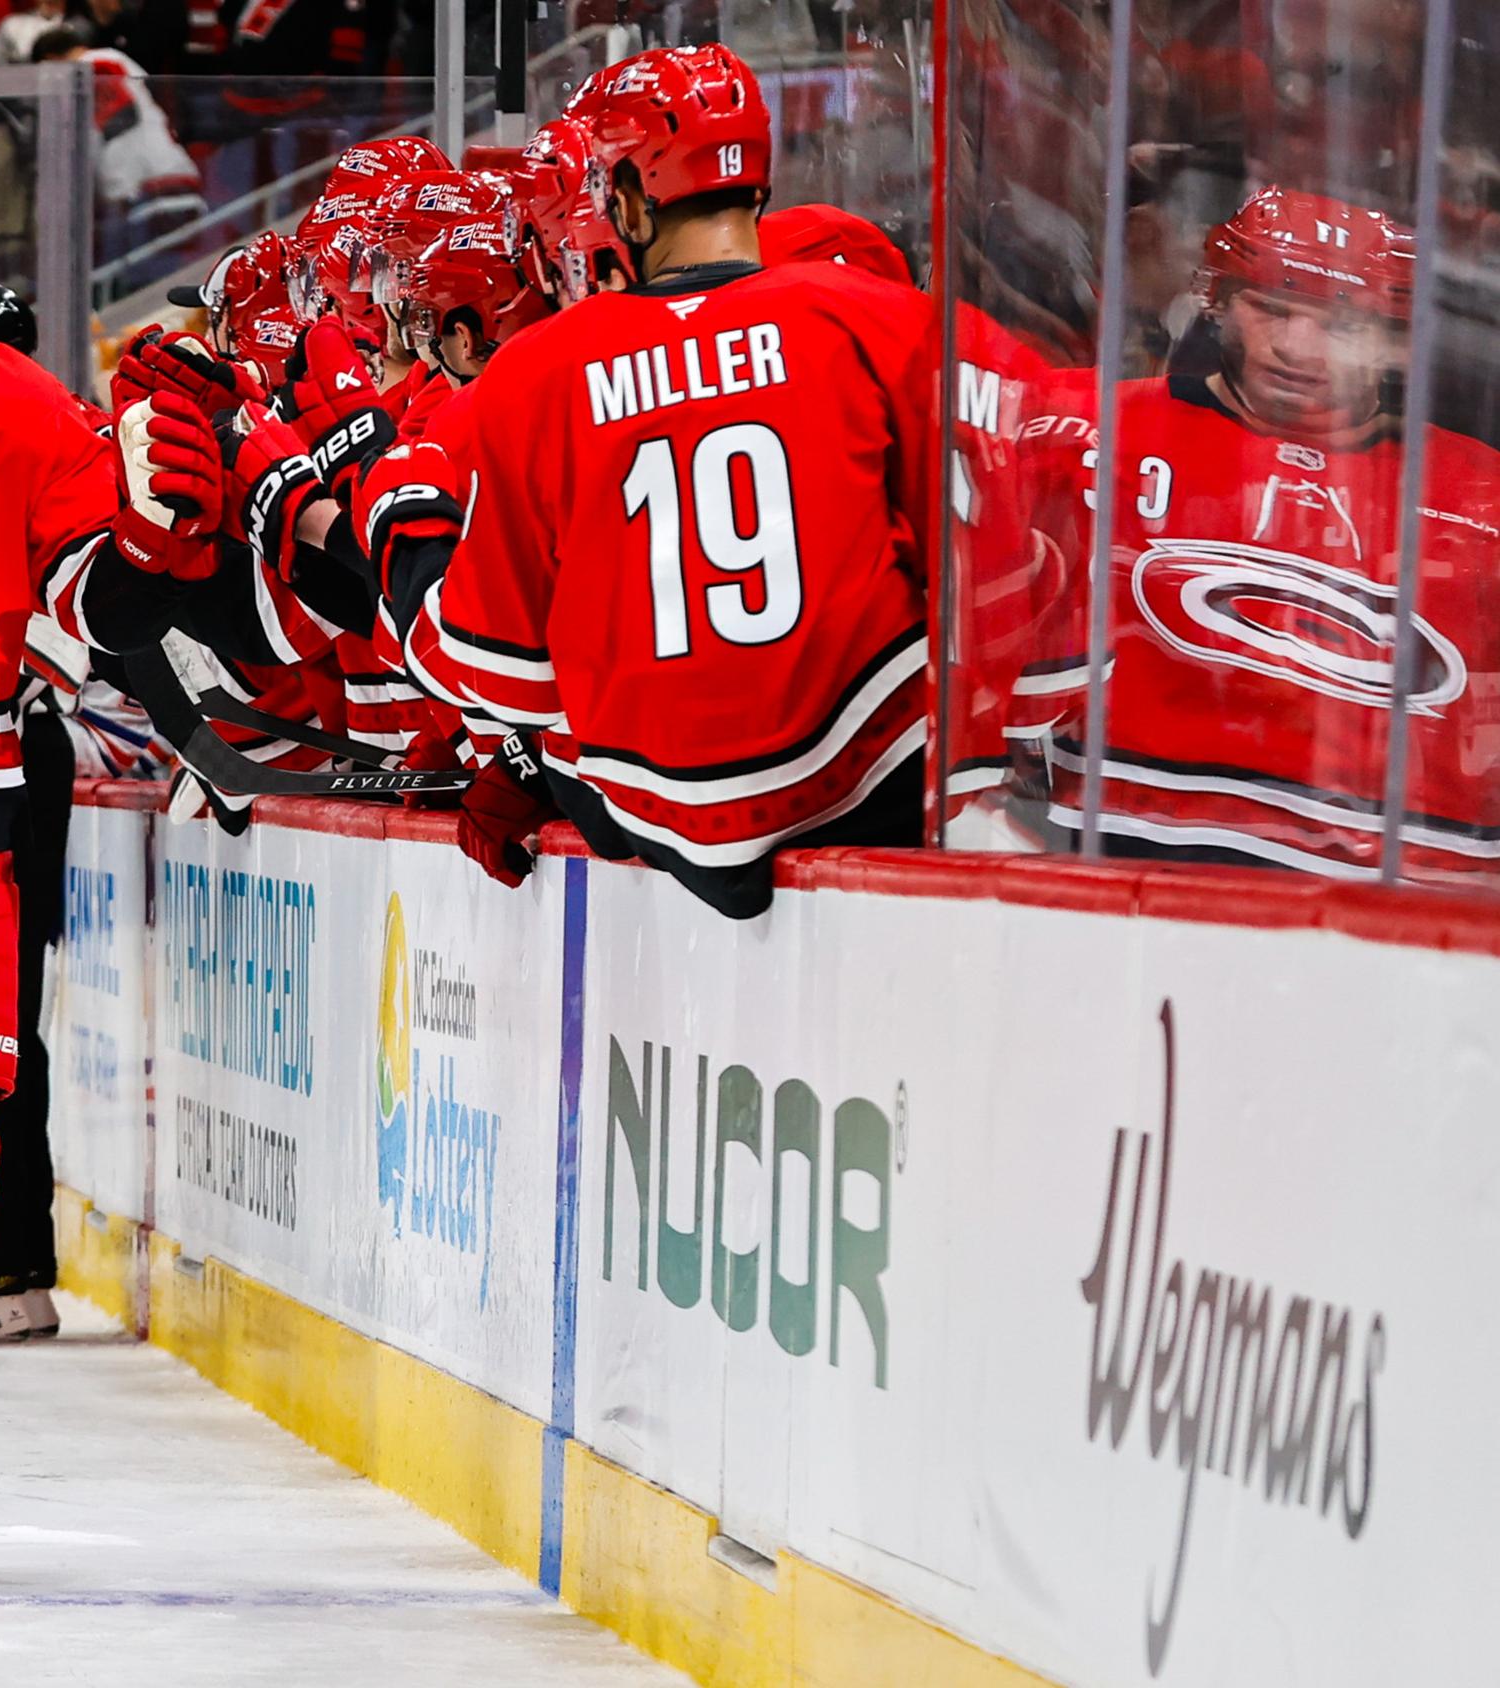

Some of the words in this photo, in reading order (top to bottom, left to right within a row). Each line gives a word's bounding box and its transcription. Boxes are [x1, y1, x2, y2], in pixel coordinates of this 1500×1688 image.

[438, 193, 472, 205] Citizens
[441, 184, 461, 194] First
[717, 143, 743, 178] 19
[472, 229, 503, 241] Citizen
[476, 221, 496, 231] First
[585, 322, 788, 426] MILLER
[621, 420, 804, 661] 19
[330, 775, 425, 790] FLYLITE
[221, 865, 316, 1100] ORTHOPAEDIC
[413, 947, 429, 1031] NC
[430, 948, 477, 1042] Education
[220, 1109, 246, 1209] TEAM
[248, 1121, 298, 1234] DOCTORS
[411, 1047, 502, 1316] Lottery
[1079, 995, 1387, 1679] Wegmans
